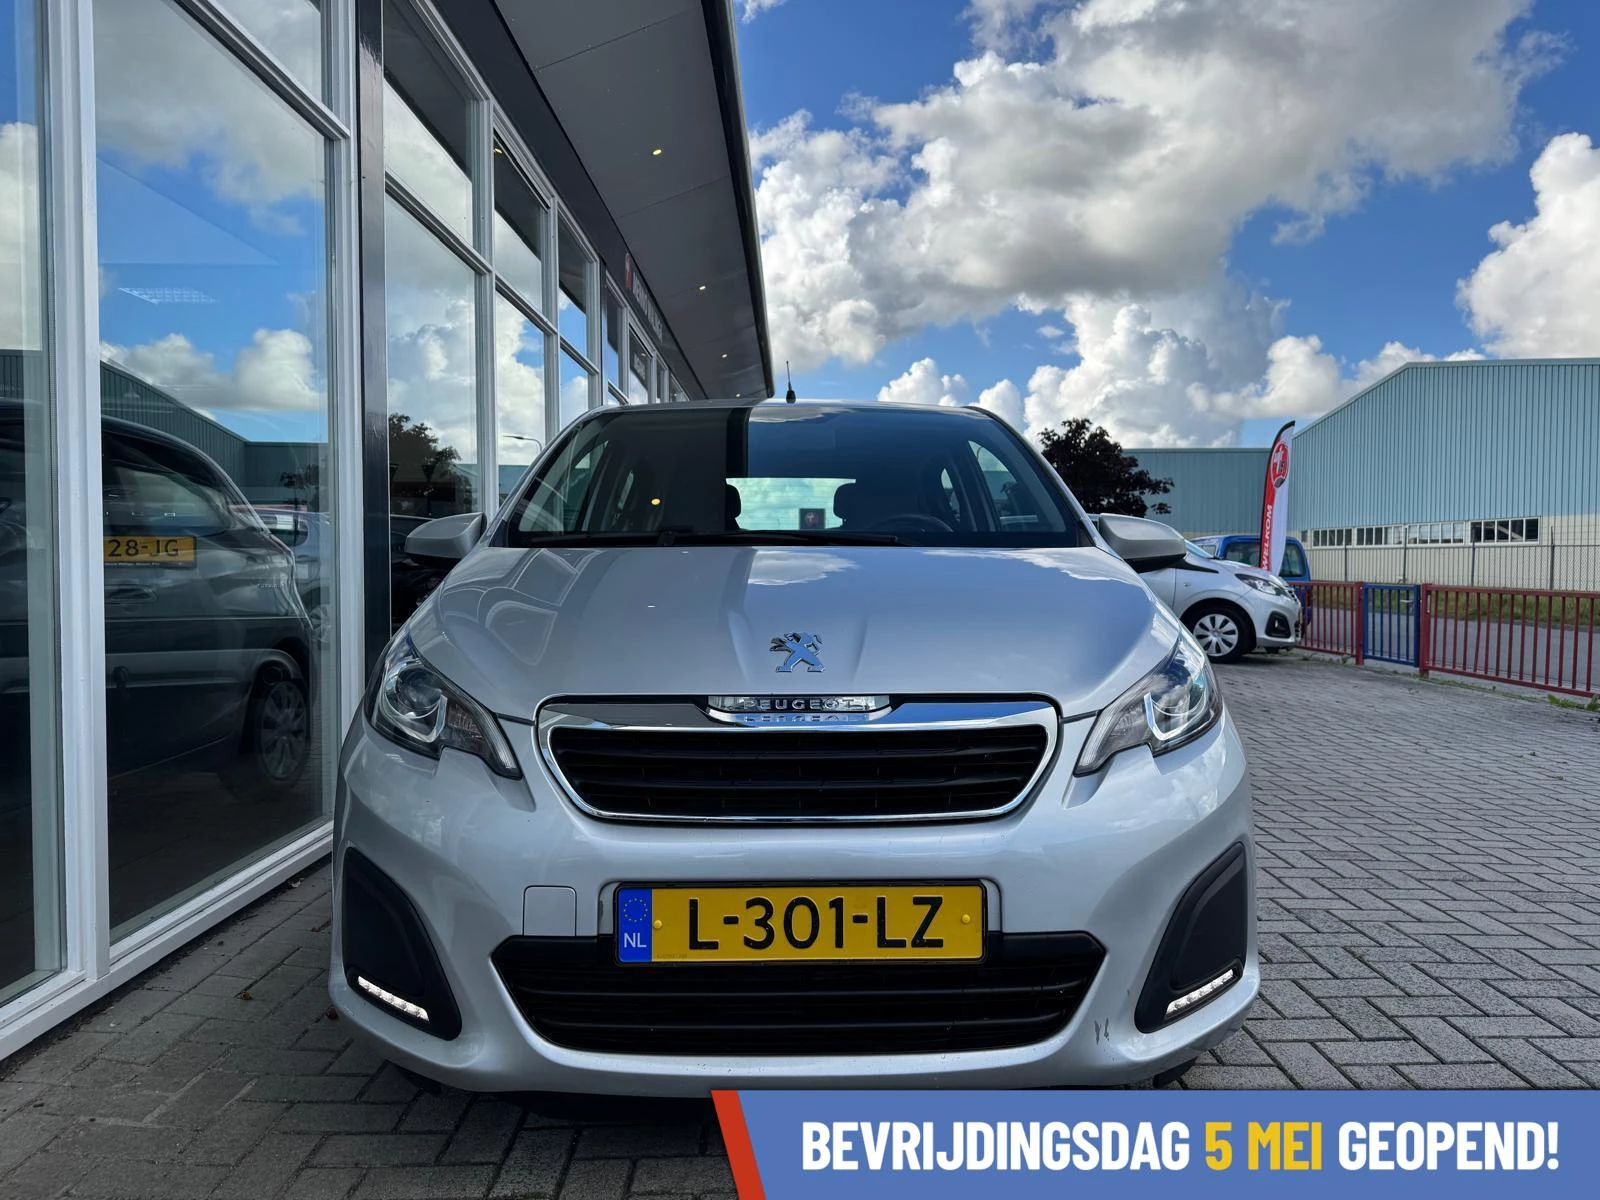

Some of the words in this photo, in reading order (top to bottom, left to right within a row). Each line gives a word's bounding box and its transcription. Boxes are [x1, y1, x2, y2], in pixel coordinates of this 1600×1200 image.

[1262, 504, 1273, 570] WELKOM
[744, 699, 855, 710] PEUGEOT
[623, 932, 647, 948] NL
[688, 896, 944, 950] L-301-LZ
